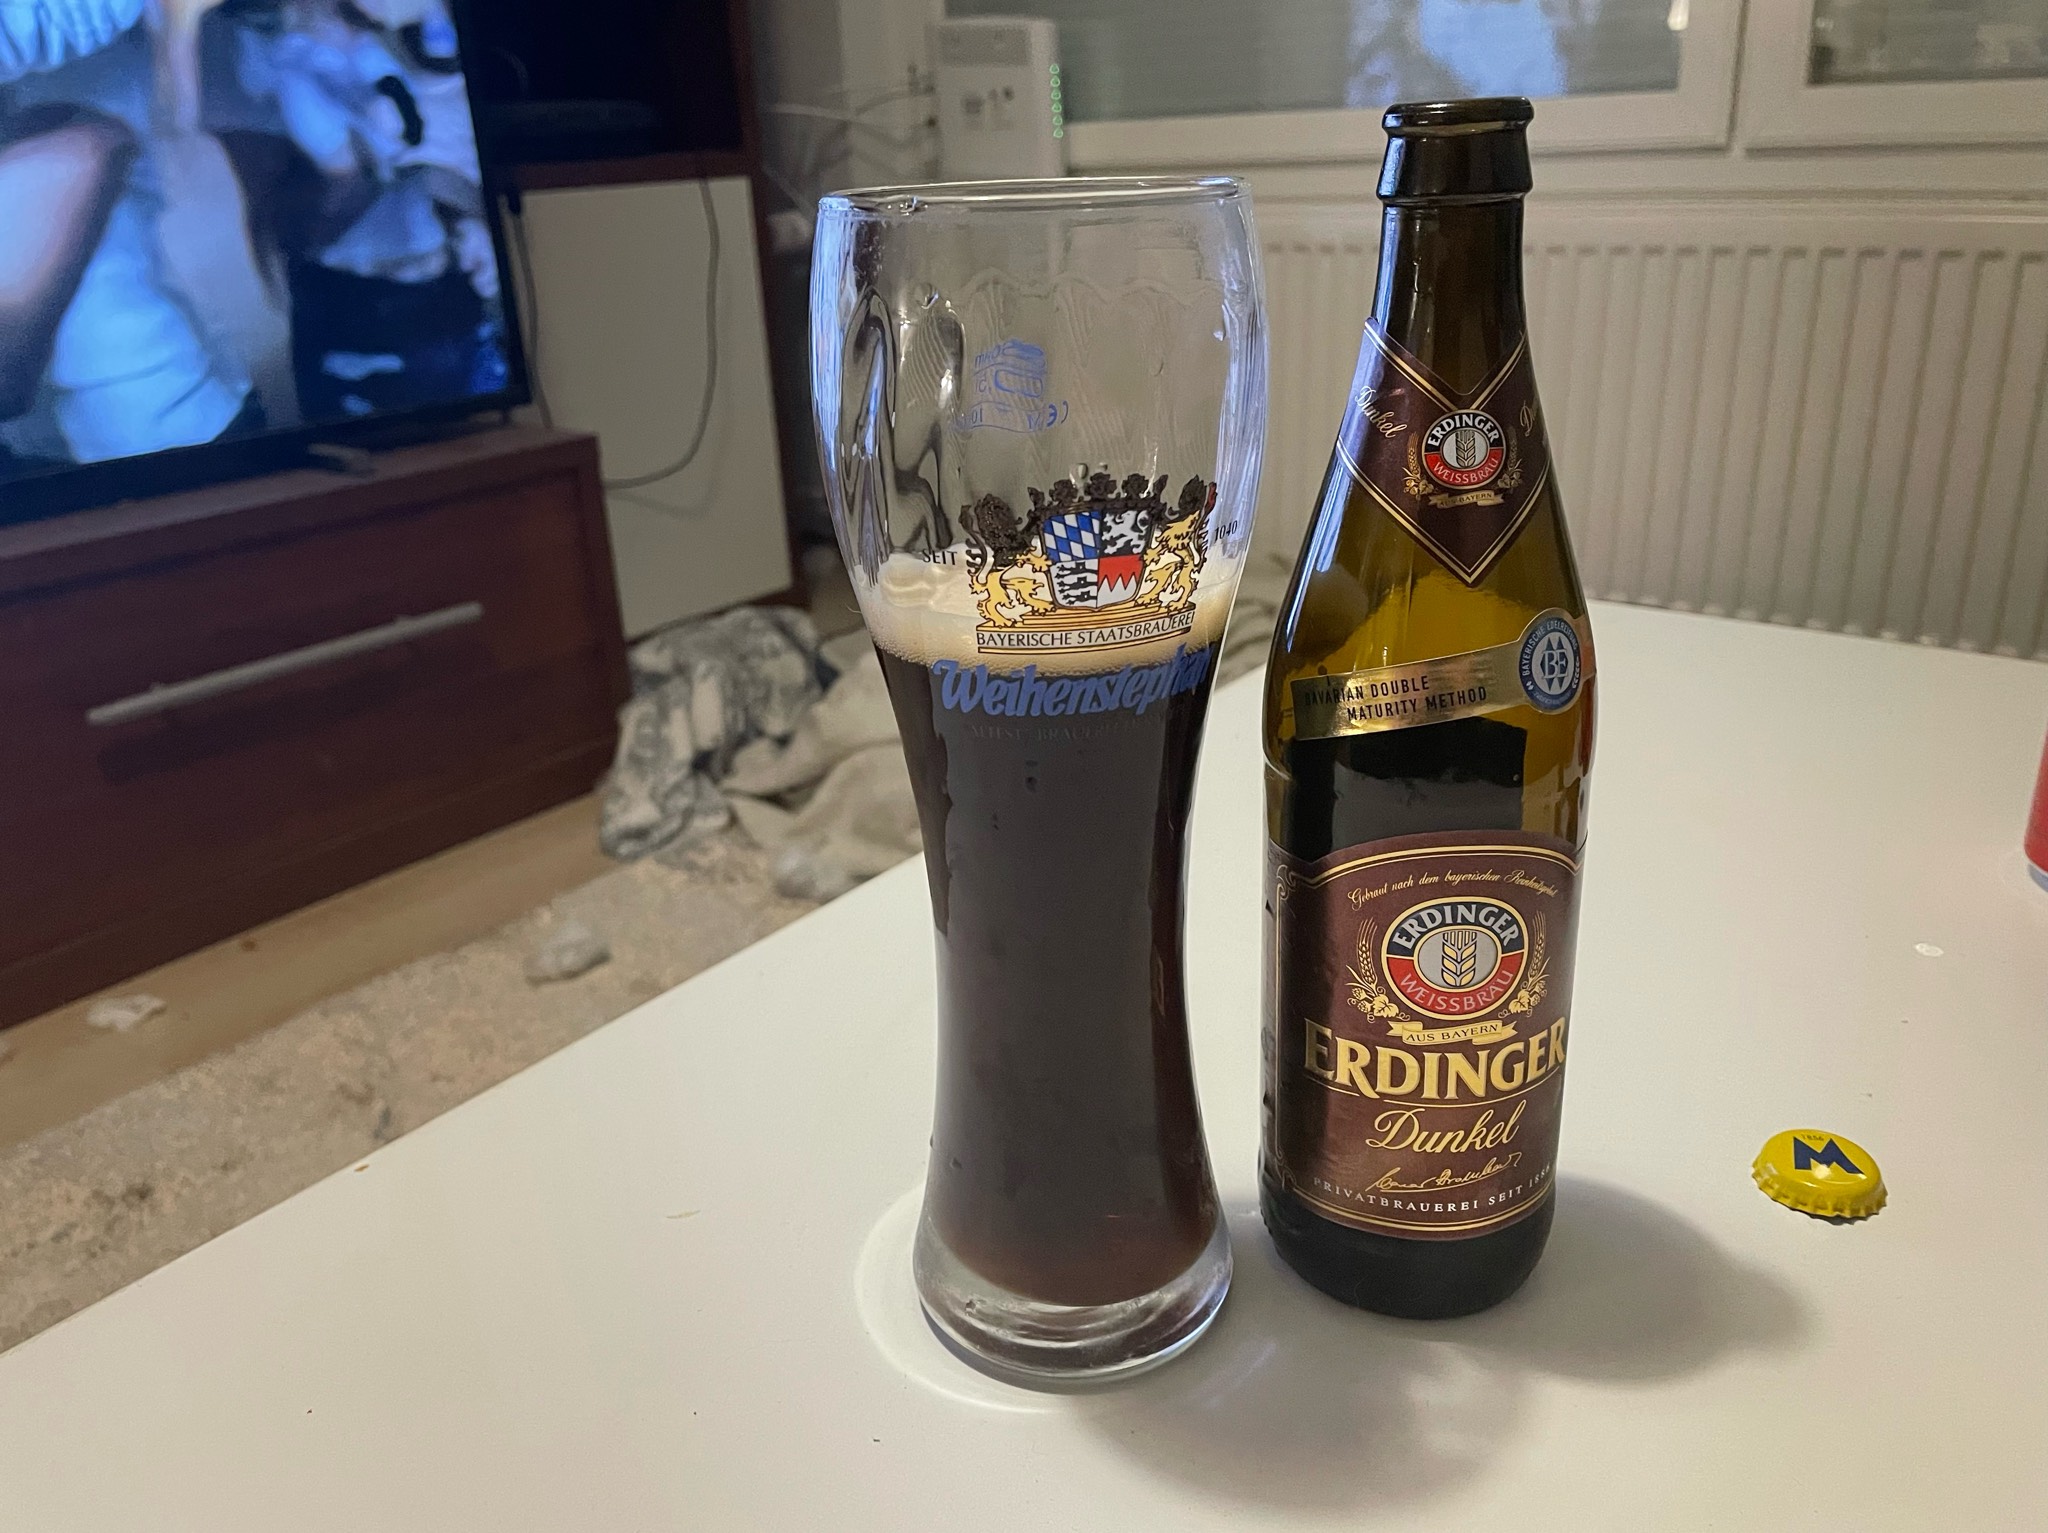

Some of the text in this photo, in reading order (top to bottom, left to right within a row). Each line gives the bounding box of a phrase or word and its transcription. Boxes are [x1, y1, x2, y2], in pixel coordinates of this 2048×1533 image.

[1354, 385, 1408, 438] Dunkel
[1427, 413, 1500, 447] ERDINGER
[1458, 492, 1492, 504] BAYERN
[1214, 519, 1238, 542] 1040
[921, 548, 958, 566] SEIT
[976, 611, 1196, 647] BAYERISCHE STAATSBRAUEREI
[1521, 625, 1547, 676] BAYERISCHE
[932, 642, 1213, 716] Weihenstephan
[1304, 676, 1430, 706] BAVARIAN DOUBLE
[1346, 686, 1487, 721] MATURITY METHOD
[1347, 883, 1388, 911] Gebraut
[1391, 875, 1414, 891] nach
[1418, 872, 1440, 885] dem
[1444, 869, 1501, 887] bayerischen
[1392, 904, 1520, 950] ERDINGER
[1400, 969, 1514, 1012] WEISSBRÄU
[1406, 1024, 1499, 1042] AUS BAYERN
[1304, 1016, 1567, 1100] ERDINGER
[1365, 1099, 1528, 1154] Dunkel
[1313, 1177, 1479, 1212] PRIVATBRAUEREI
[1488, 1185, 1524, 1205] SEIT
